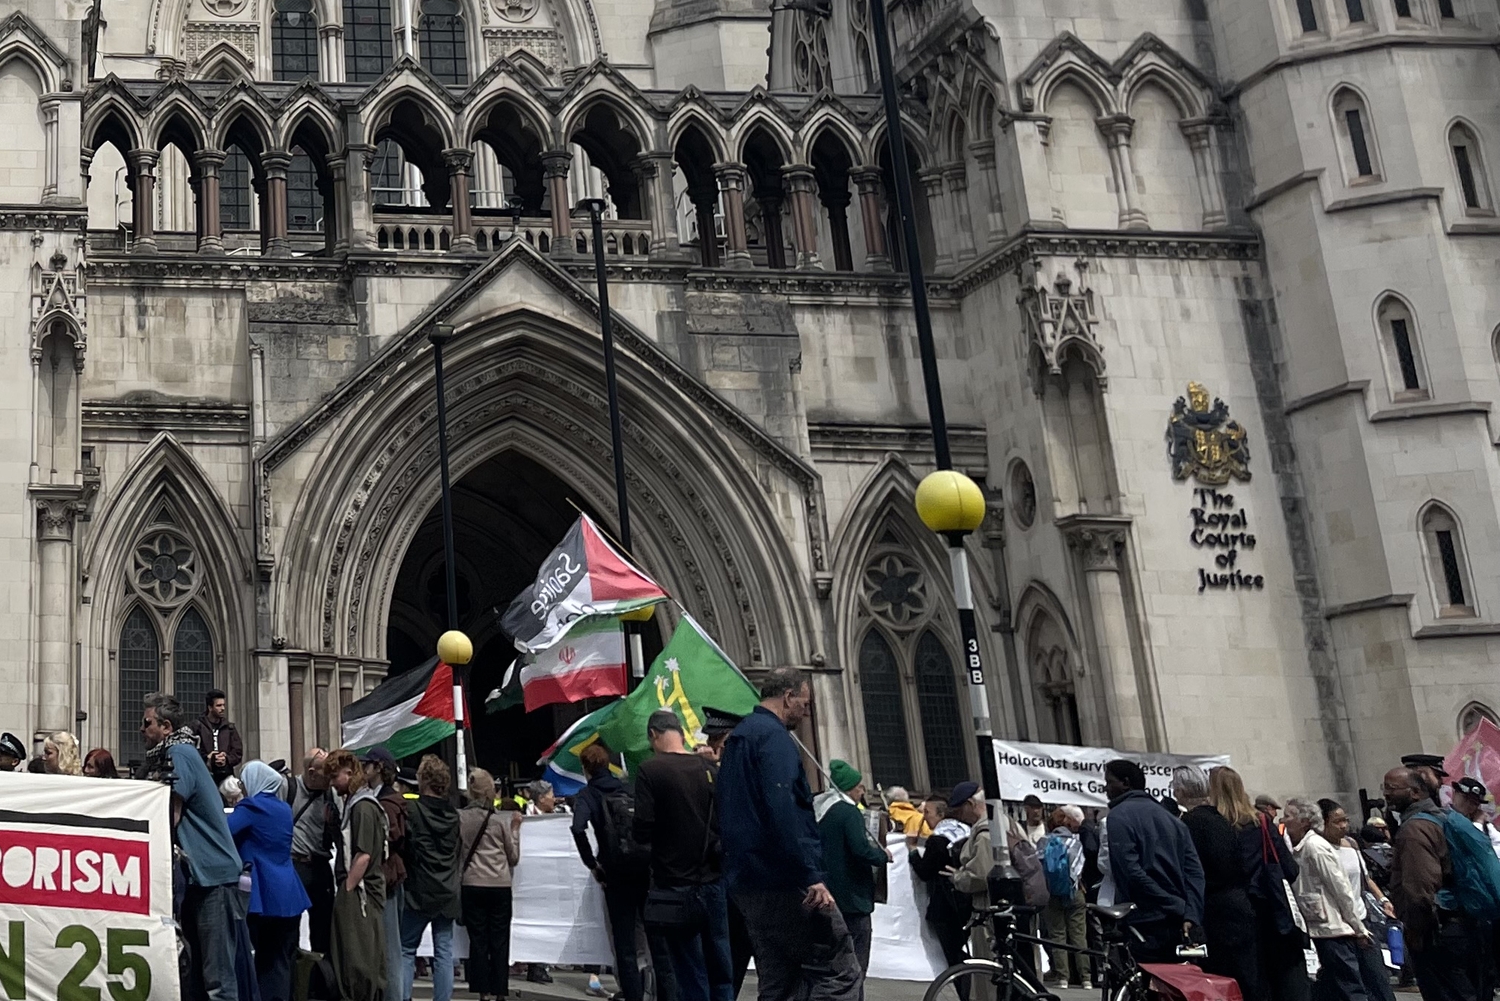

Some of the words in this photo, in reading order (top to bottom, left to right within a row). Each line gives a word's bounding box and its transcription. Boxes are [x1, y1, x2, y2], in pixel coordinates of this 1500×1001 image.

[1193, 488, 1234, 509] The
[1190, 507, 1248, 531] Royal
[1190, 528, 1256, 550] Courts
[1215, 549, 1237, 570] of
[1198, 568, 1264, 594] Justice
[998, 752, 1068, 770] Holocaust
[1073, 761, 1107, 773] survi
[1033, 778, 1083, 793] against
[55, 925, 152, 1001] 25
